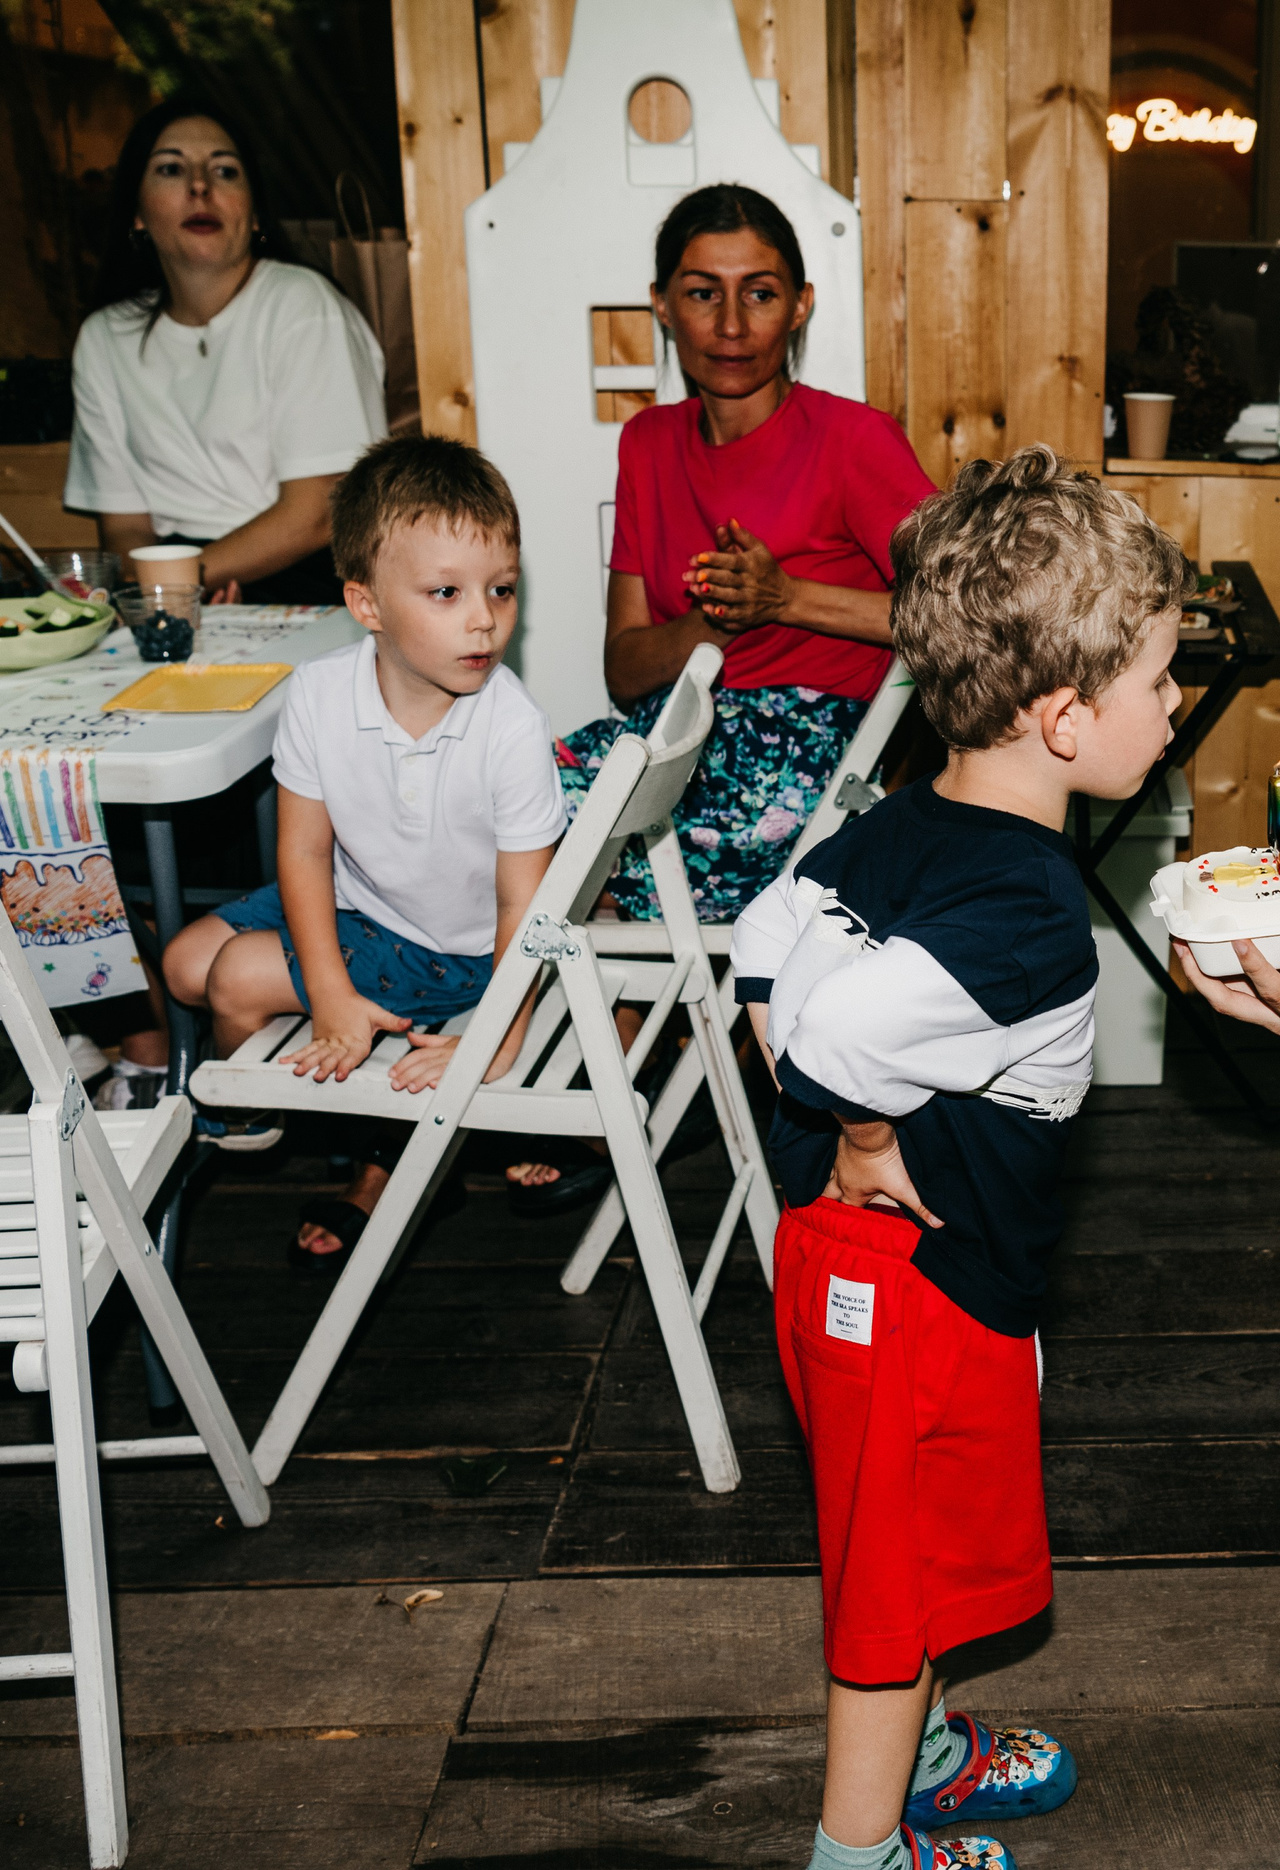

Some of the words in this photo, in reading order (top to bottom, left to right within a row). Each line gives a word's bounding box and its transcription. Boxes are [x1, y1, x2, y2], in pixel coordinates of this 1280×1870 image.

[833, 1292, 841, 1300] THE
[842, 1295, 857, 1303] VOICE
[848, 1305, 868, 1313] SPEAKS
[845, 1321, 859, 1329] SOUL
